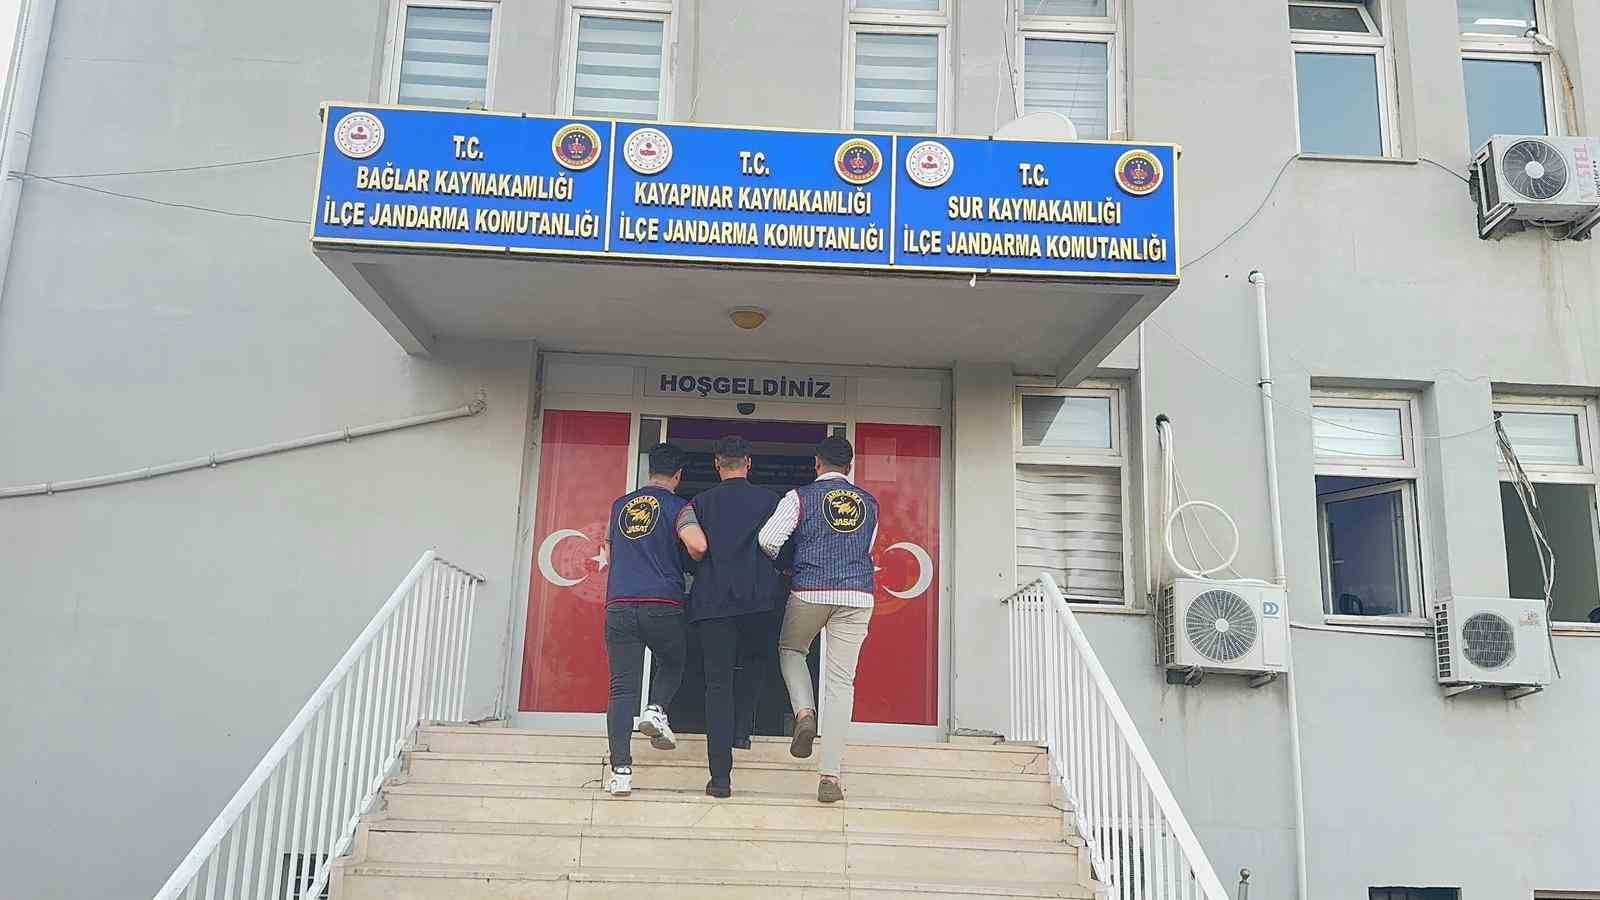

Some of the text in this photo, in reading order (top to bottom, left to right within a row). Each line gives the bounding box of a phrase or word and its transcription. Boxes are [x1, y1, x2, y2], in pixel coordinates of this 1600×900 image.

[453, 135, 484, 160] T.C.
[739, 151, 770, 175] T.C.
[1019, 163, 1049, 187] T.C.
[356, 162, 574, 200] BAĞLAR KAYMAKAMLIĞI
[635, 182, 872, 215] KAYAPINAR KAYMAKAMLIĞI
[948, 195, 1121, 225] SUR KAYMAKAMLIĞI
[323, 195, 600, 239] İLÇE JANDARMA KOMUTANLIĞI
[619, 211, 884, 252] İLÇE JANDARMA KOMUTANLIĞI
[903, 223, 1167, 262] İLÇE JANDARMA KOMUTANLIĞI
[660, 374, 831, 398] HOŞGELDİNİZ
[626, 525, 649, 534] JASAT
[833, 518, 857, 526] JASAT
